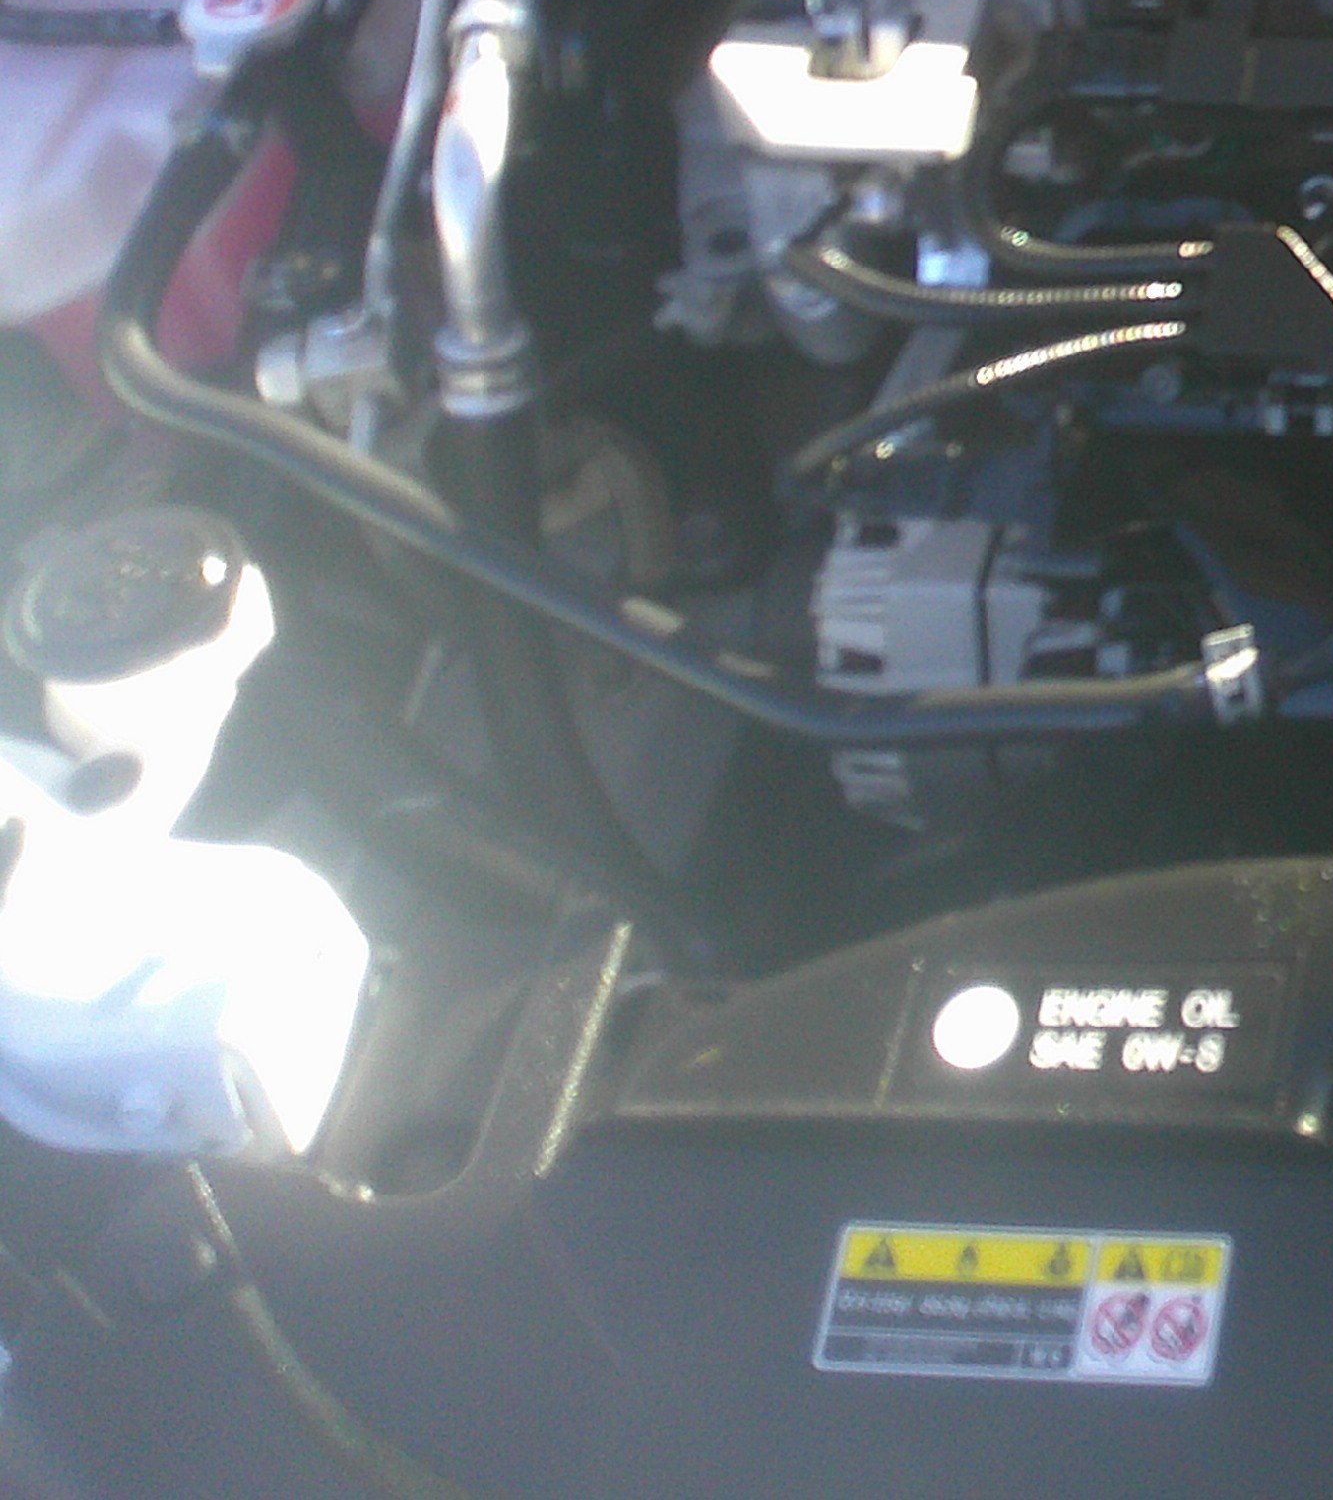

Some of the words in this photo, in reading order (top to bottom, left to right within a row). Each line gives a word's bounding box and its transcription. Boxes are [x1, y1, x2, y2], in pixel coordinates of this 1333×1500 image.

[1039, 987, 1170, 1027] ENGINE
[1181, 988, 1240, 1027] OIL
[1029, 1029, 1107, 1069] SAE
